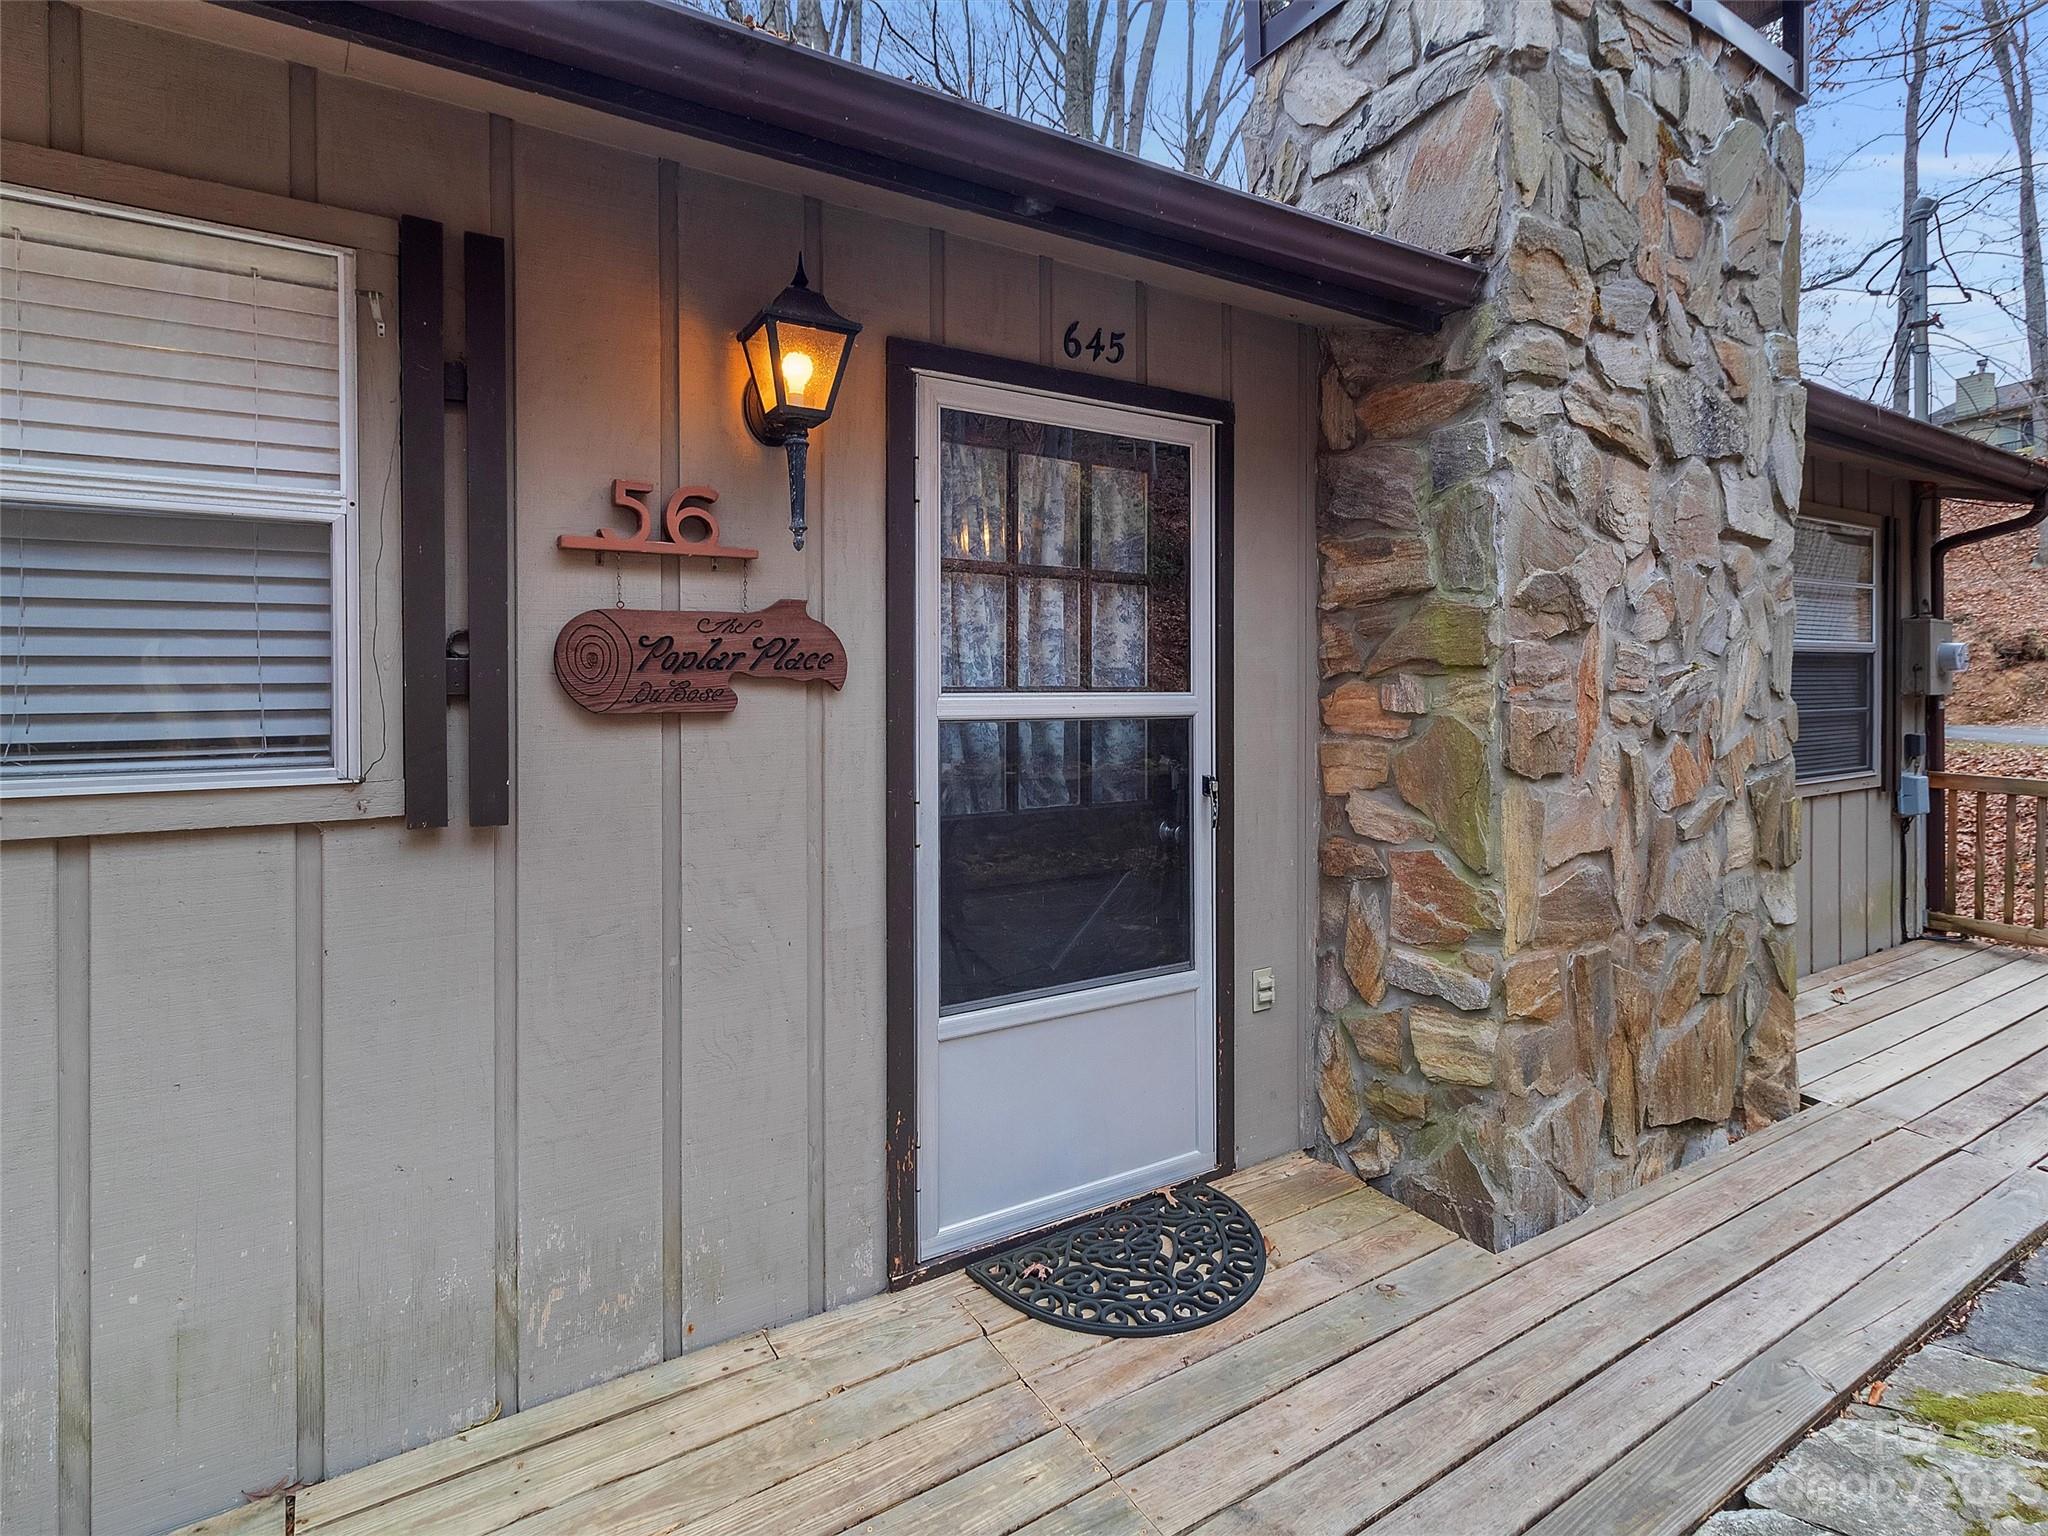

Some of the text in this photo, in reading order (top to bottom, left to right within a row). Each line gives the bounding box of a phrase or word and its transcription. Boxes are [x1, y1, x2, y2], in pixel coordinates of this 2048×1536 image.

[1063, 320, 1126, 364] 645
[598, 479, 720, 546] 56
[637, 635, 834, 674] Poplar Place
